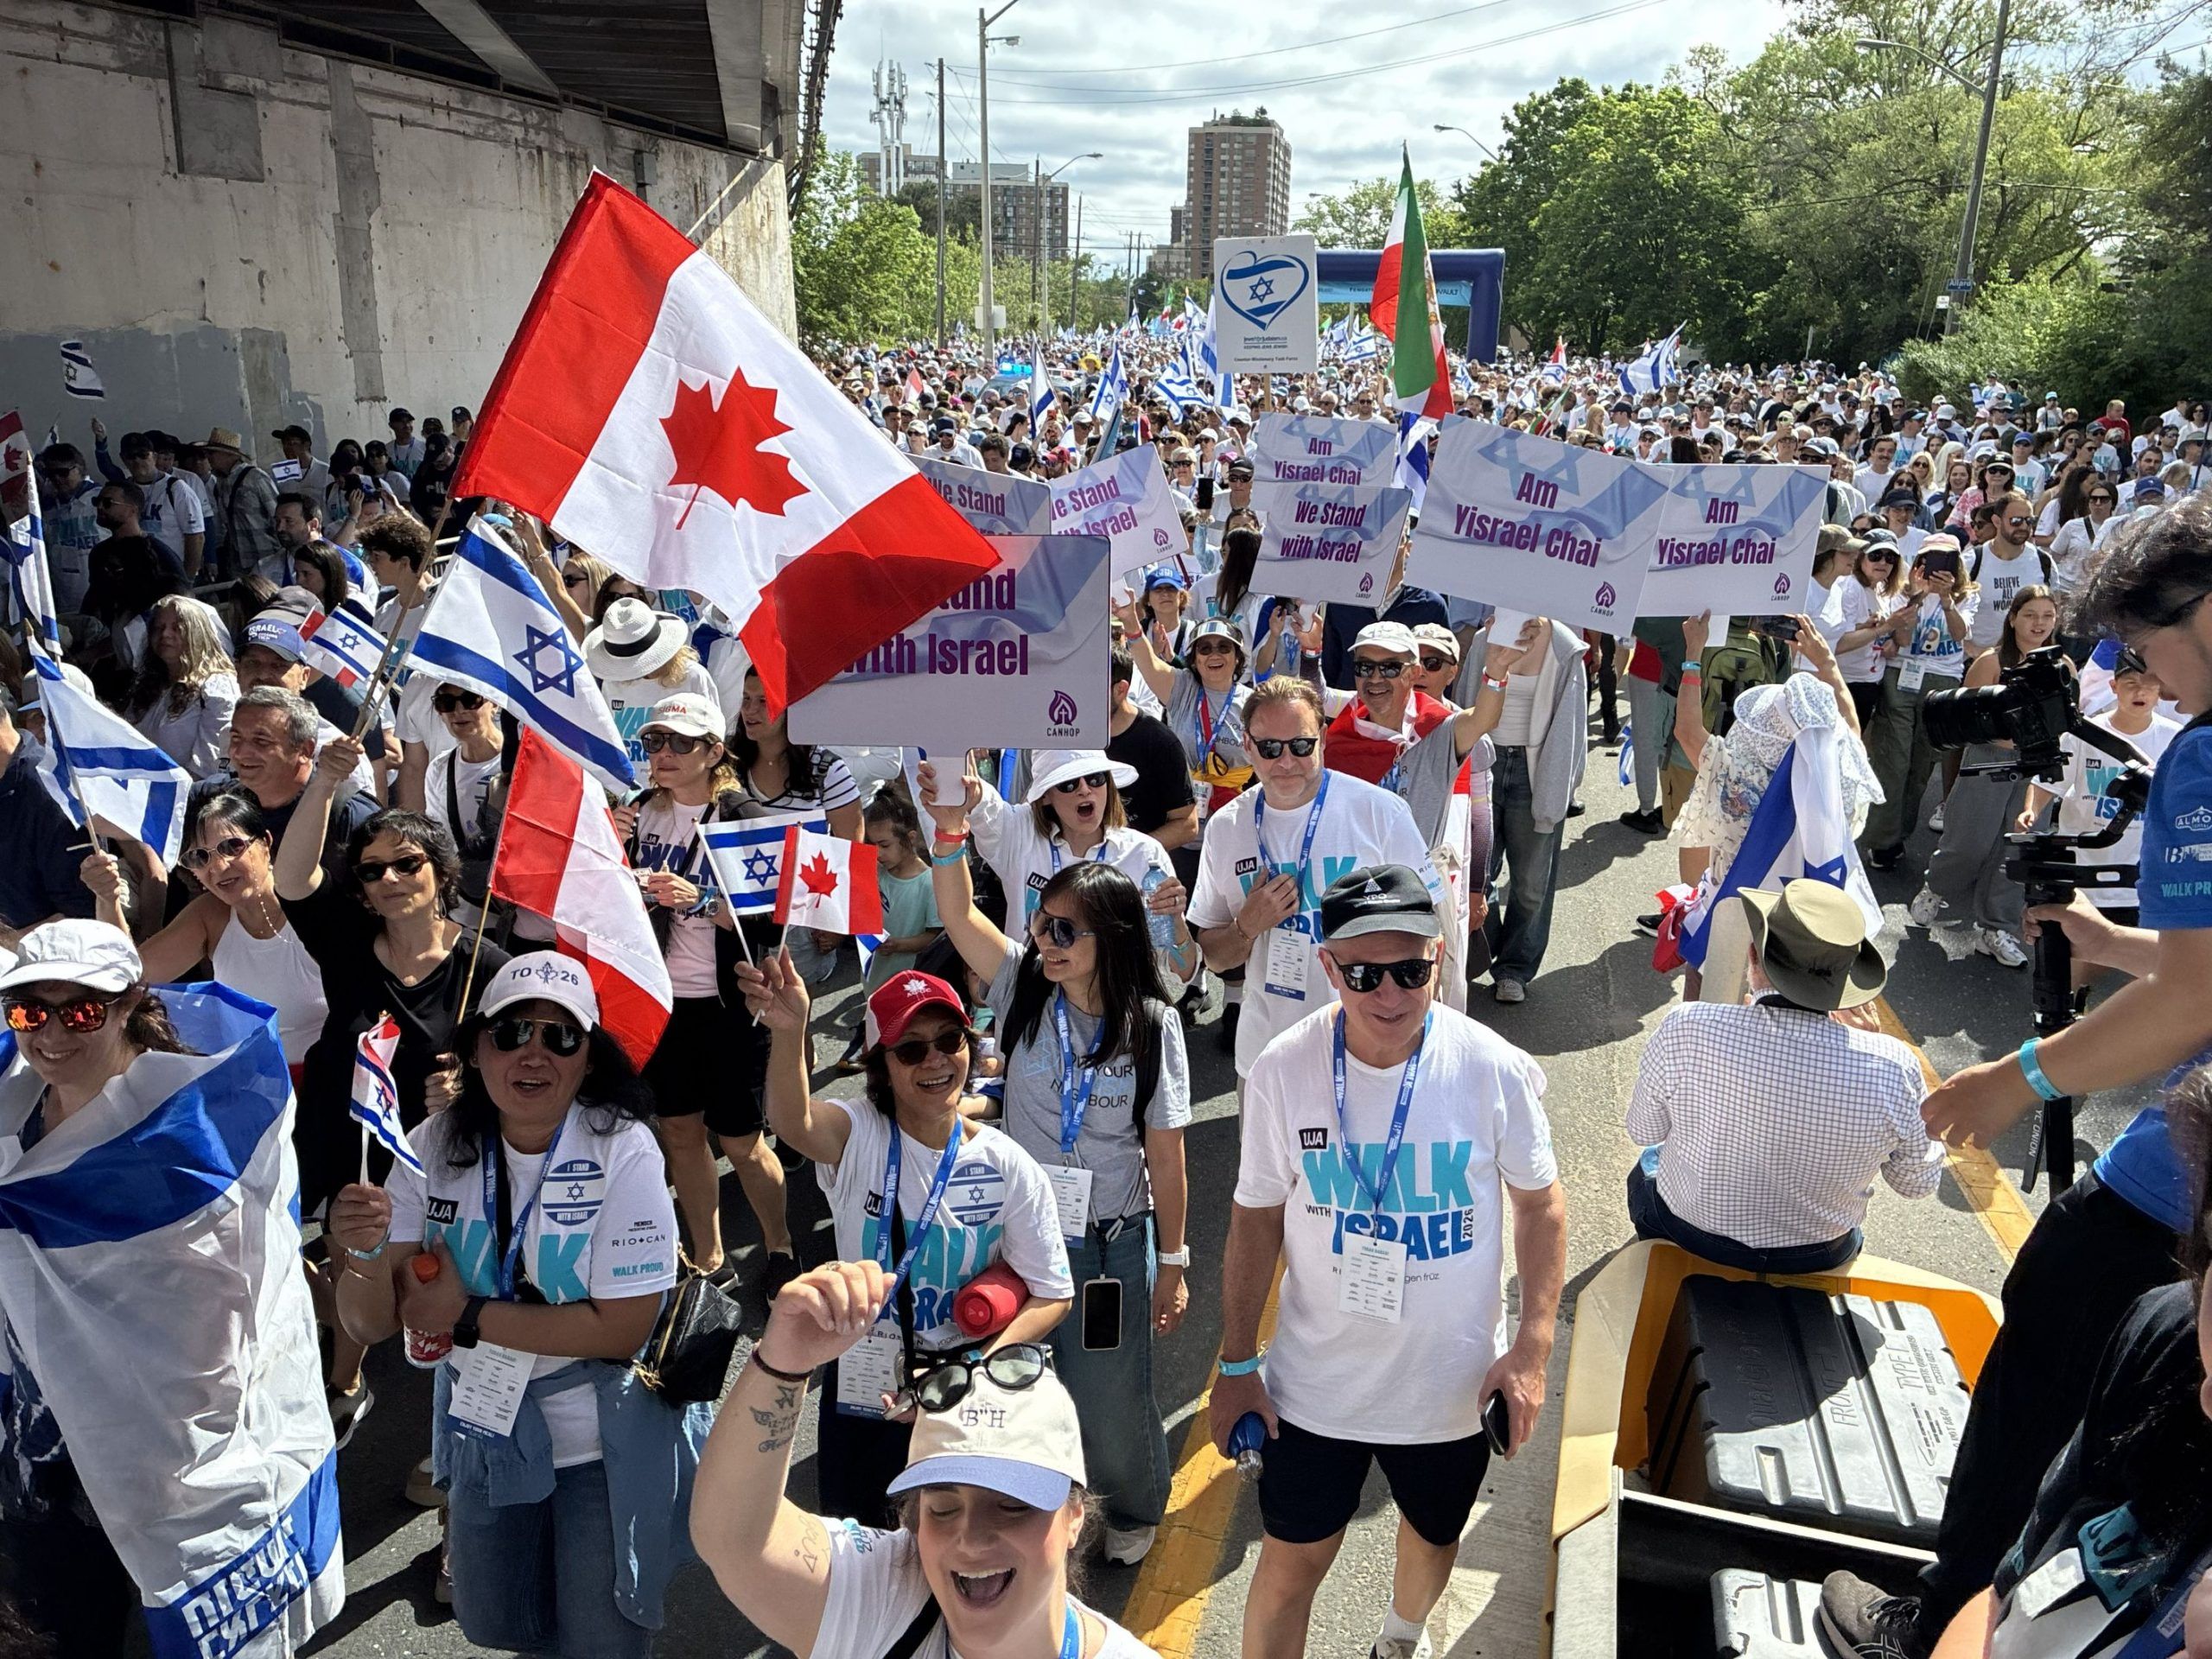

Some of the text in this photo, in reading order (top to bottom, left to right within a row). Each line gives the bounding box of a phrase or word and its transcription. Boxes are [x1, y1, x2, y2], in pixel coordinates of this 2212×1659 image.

[1308, 437, 1332, 456] Am
[1274, 461, 1362, 486] Yisrael Chai
[957, 484, 1006, 518] Stand
[1068, 474, 1121, 513] Stand
[1516, 472, 1559, 509] Am
[1294, 500, 1367, 528] We Stand
[1705, 498, 1738, 524] Am
[1280, 534, 1363, 563] with Israel
[1453, 504, 1603, 568] Yisrael Chai
[1657, 537, 1777, 565] Yisrael Chai
[1993, 575, 2020, 589] BELIEVE
[2002, 588, 2013, 600] ALL
[1590, 605, 1614, 617] CANHOP
[928, 633, 1029, 676] Israel
[658, 705, 687, 715] SIGMA
[1046, 728, 1081, 738] CANHOP
[1236, 860, 1255, 873] UJA
[2161, 881, 2193, 898] WALK
[510, 967, 579, 986] TO 26
[1094, 1065, 1134, 1078] YOUR
[1402, 1064, 1418, 1089] WALK
[1334, 1075, 1345, 1099] WALK
[1303, 1135, 1324, 1146] UJA
[885, 1173, 897, 1201] WALK
[1302, 1141, 1474, 1213] WALK
[867, 1194, 882, 1214] UJ
[922, 1195, 939, 1223] WALK
[1305, 1204, 1332, 1218] WITH
[1462, 1209, 1474, 1239] 2026
[612, 1262, 664, 1277] WALK PROUD
[1888, 1353, 1923, 1389] TYPE
